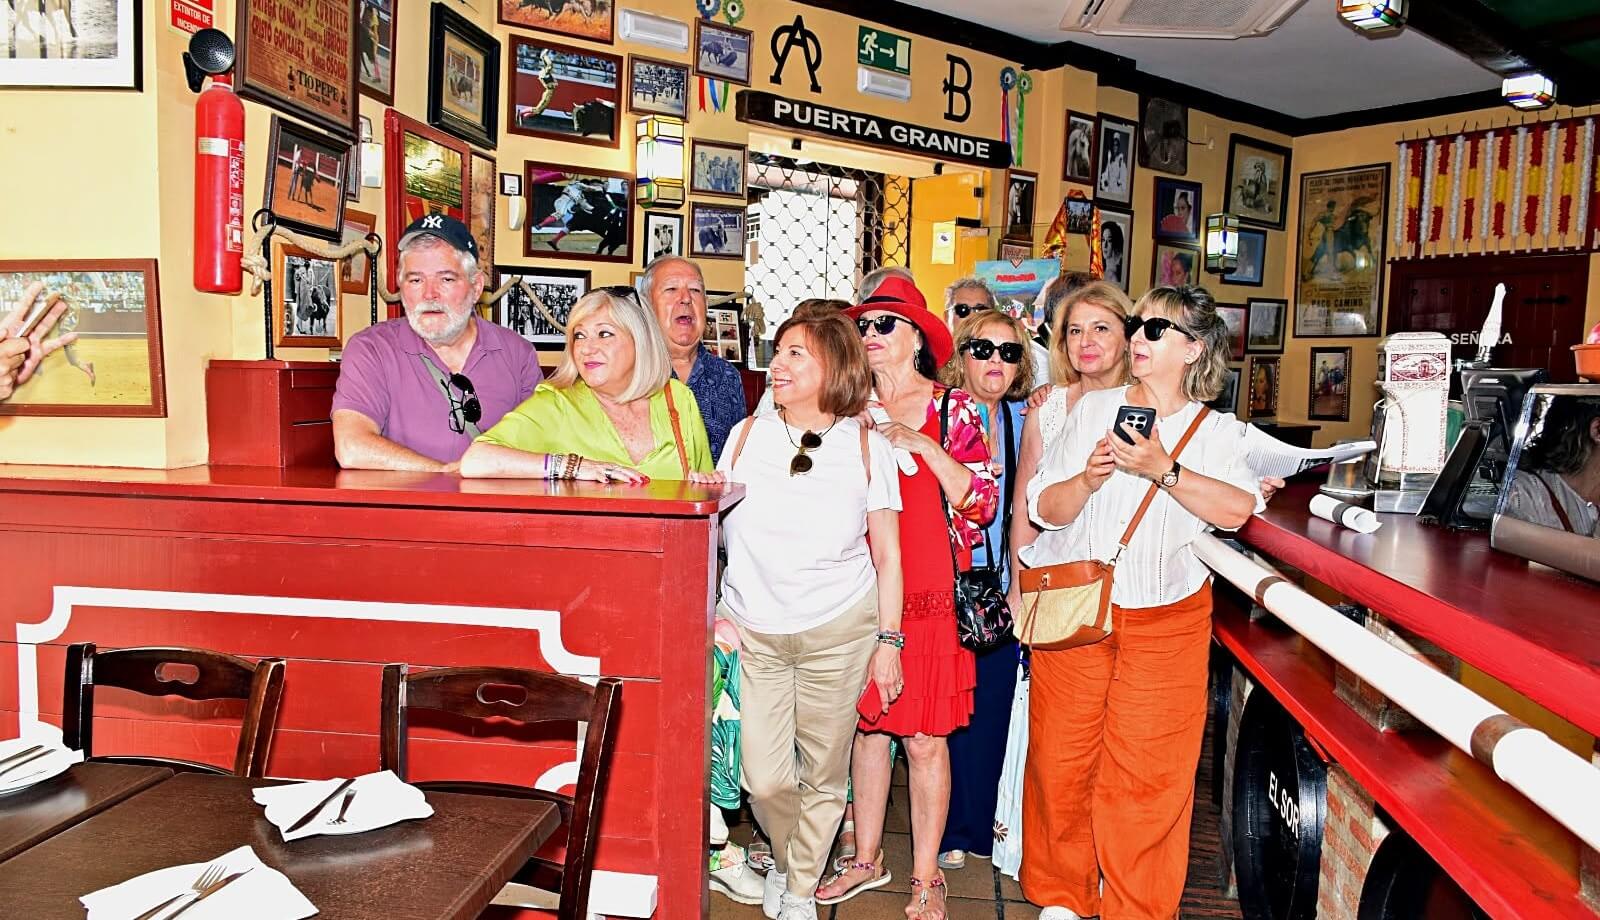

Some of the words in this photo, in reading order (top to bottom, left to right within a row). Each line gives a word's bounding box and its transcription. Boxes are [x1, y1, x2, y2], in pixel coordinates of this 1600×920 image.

[173, 0, 202, 21] EXTINTOR
[202, 14, 211, 26] DE
[296, 69, 315, 90] TIO
[314, 77, 339, 102] PEPE
[773, 99, 883, 139] PUERTA
[890, 125, 990, 159] GRANDE
[1450, 330, 1513, 345] SEÑA
[1268, 770, 1279, 810] EL
